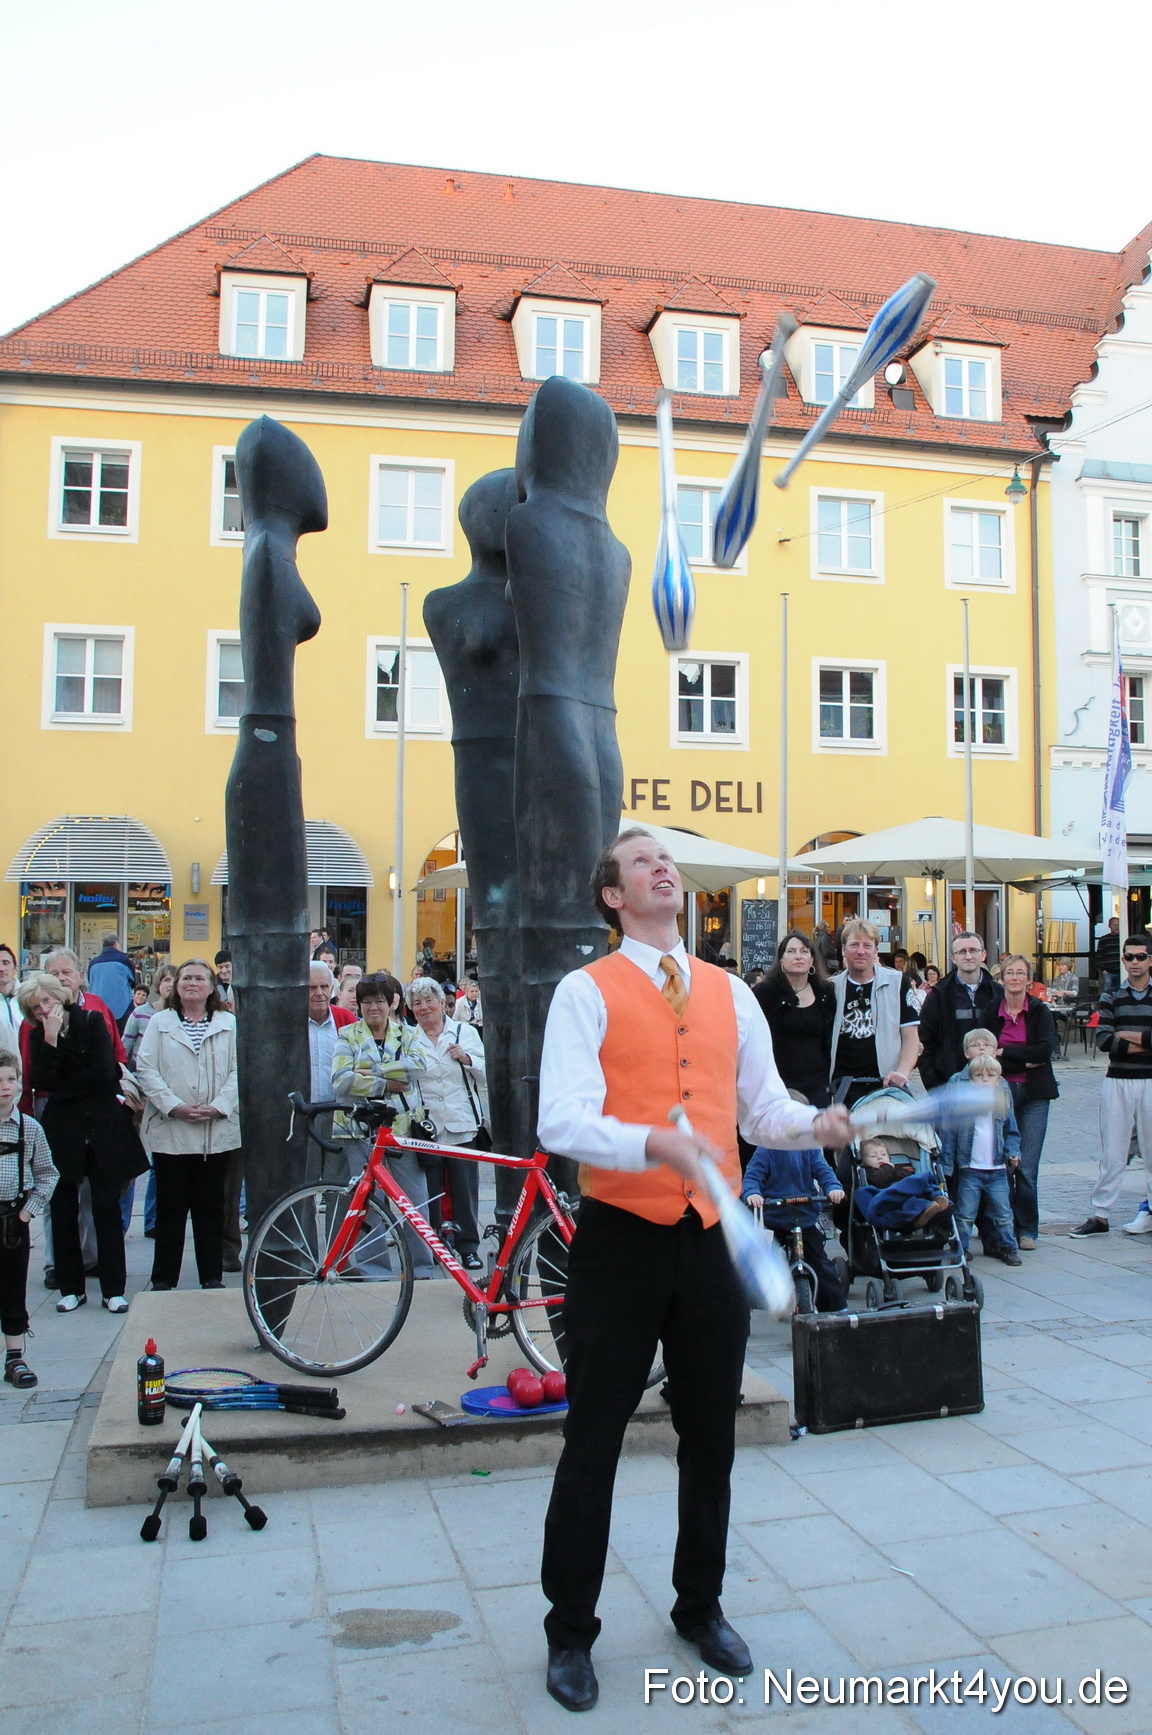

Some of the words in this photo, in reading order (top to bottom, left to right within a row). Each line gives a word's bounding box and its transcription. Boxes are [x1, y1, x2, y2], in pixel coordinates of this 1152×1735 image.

[621, 778, 670, 810] FE
[691, 780, 762, 813] DELI
[403, 1139, 440, 1150] S-WORKS
[397, 1195, 463, 1271] SPECIALIZED
[508, 1187, 528, 1238] SPECIALIZED
